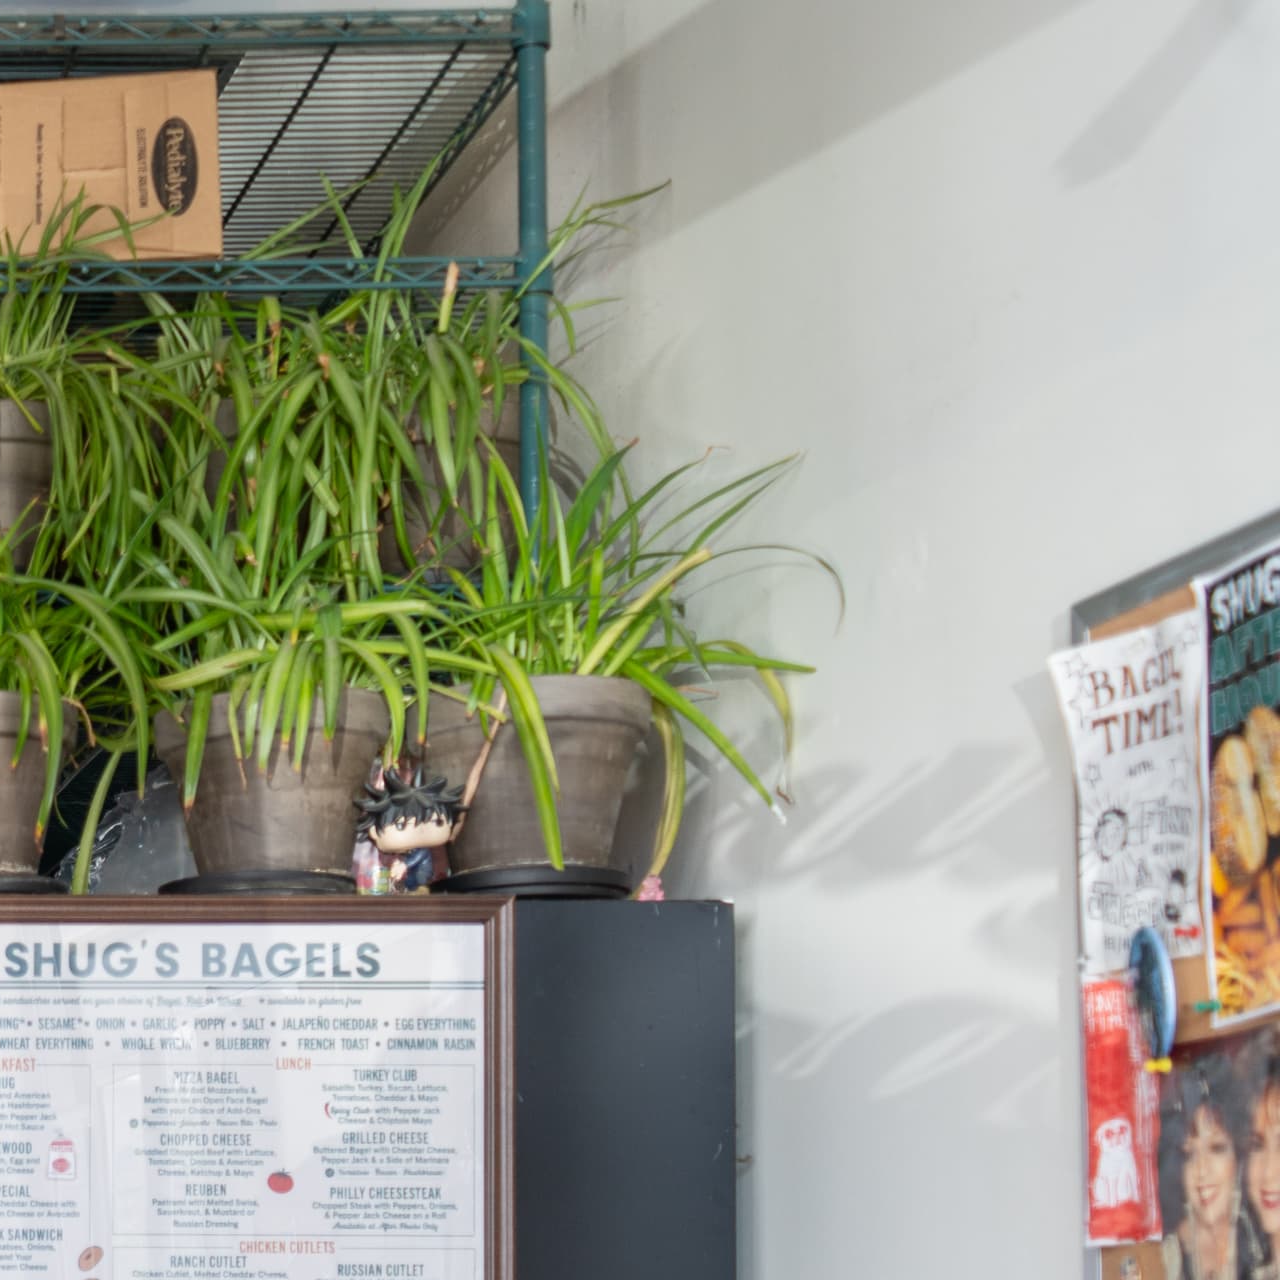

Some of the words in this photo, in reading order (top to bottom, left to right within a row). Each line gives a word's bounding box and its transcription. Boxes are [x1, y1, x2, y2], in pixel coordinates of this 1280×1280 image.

[4, 939, 180, 978] SHUG'S
[202, 942, 380, 978] BAGELS
[96, 1018, 125, 1030] ONION
[143, 1018, 176, 1030] GARLIC
[194, 1018, 226, 1030] POPPY
[242, 1018, 265, 1030] SALT
[282, 1016, 330, 1030] JALAPEÑO
[332, 1018, 378, 1030] CHEDDAR
[396, 1018, 414, 1030] EGG
[417, 1018, 476, 1030] EVERYTHING
[36, 1038, 94, 1050] EVERYTHING
[216, 1038, 270, 1050] BLUEBERRY
[298, 1038, 335, 1050] FRENCH
[341, 1038, 369, 1050] TOAST
[388, 1038, 438, 1050] CINNAMON
[444, 1038, 476, 1050] RAISIN
[276, 1058, 312, 1070] LUNCH
[353, 1069, 389, 1081] TURKEY
[392, 1069, 417, 1081] CLUB
[160, 1133, 208, 1146] CHOPPED
[212, 1134, 252, 1146] CHEESE
[186, 1184, 227, 1196] REUBEN
[330, 1187, 365, 1199] PHILLY
[369, 1187, 441, 1199] CHEESESTEAK
[7, 1229, 63, 1241] SANDWICH
